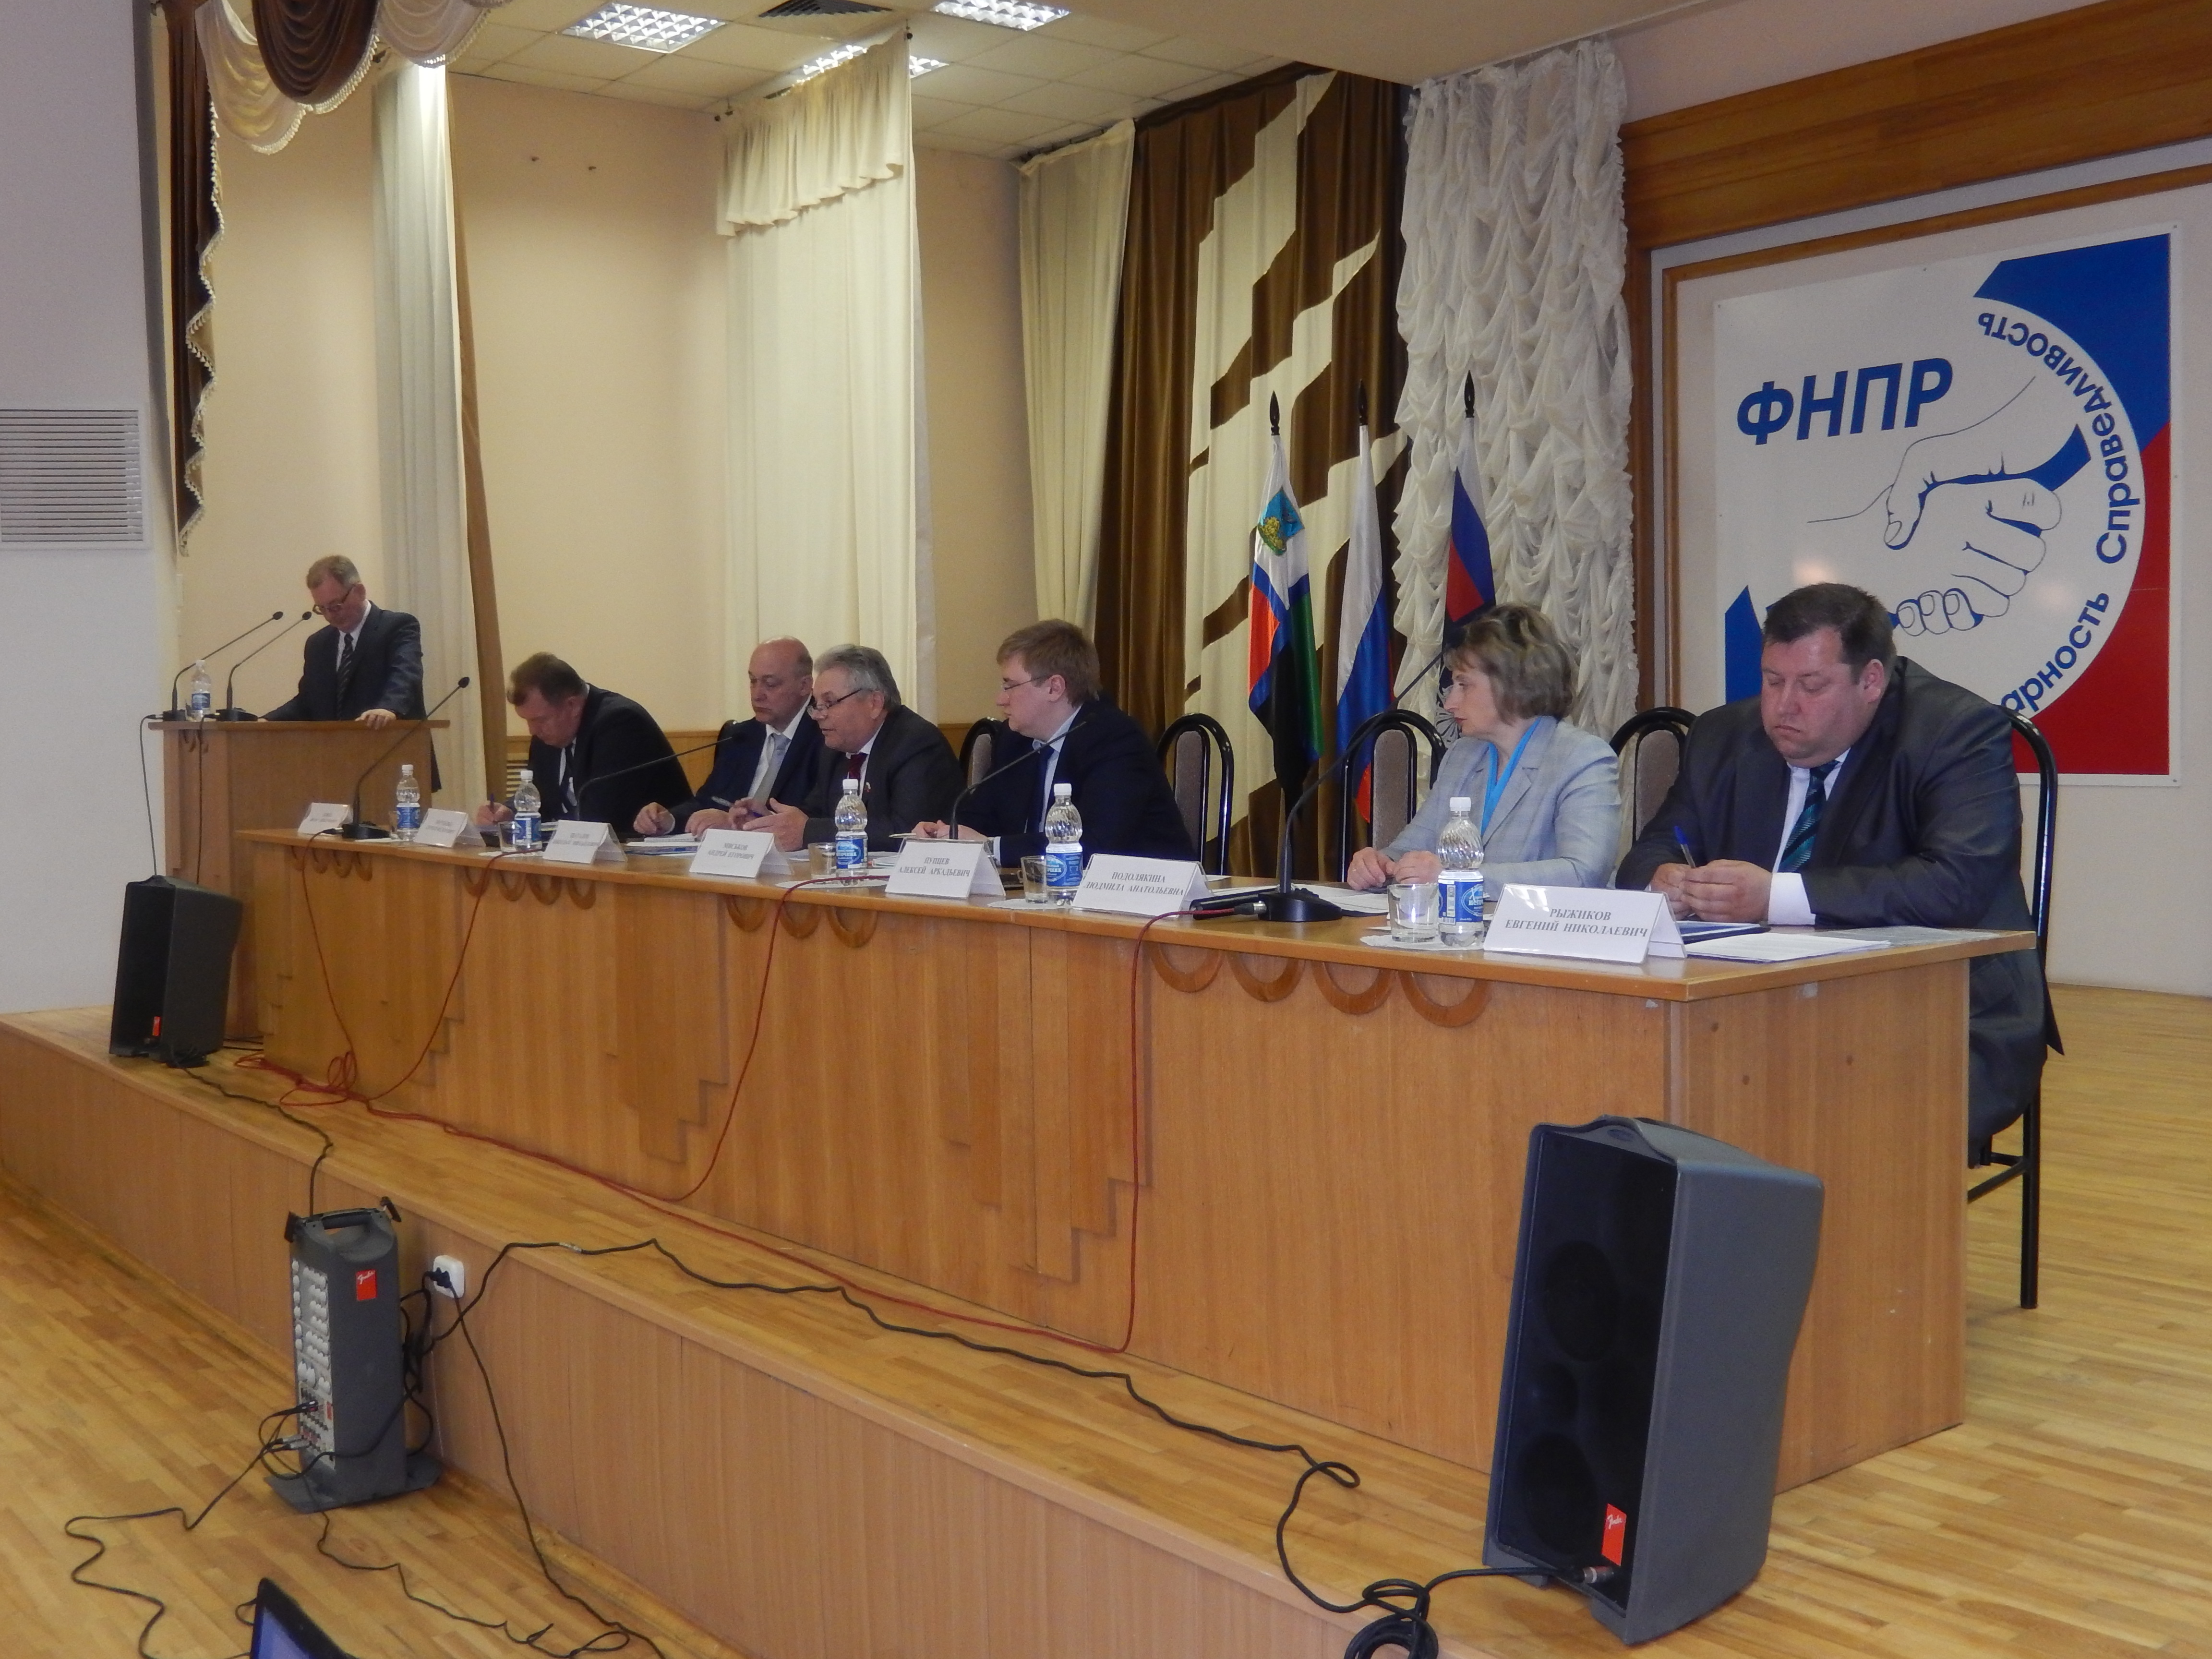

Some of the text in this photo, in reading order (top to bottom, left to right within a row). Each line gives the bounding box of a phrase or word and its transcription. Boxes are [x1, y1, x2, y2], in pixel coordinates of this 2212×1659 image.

[1737, 358, 1953, 445] ФНПР
[1978, 312, 2140, 564] Справедливость
[2001, 593, 2109, 712] арность
[900, 866, 971, 877] АЛЕКСЕЙ АРКАДЬЕВИЧ
[1111, 872, 1166, 883] ПОДОЛЯКИНА
[1084, 881, 1184, 896] ЛЮДМИЛА АНАТОЛЬЕВНА
[1549, 908, 1611, 921] РЫЖИКОВ
[1505, 919, 1648, 937] ЕВГЕНИЙ НИКОЛАЕВИЧ
